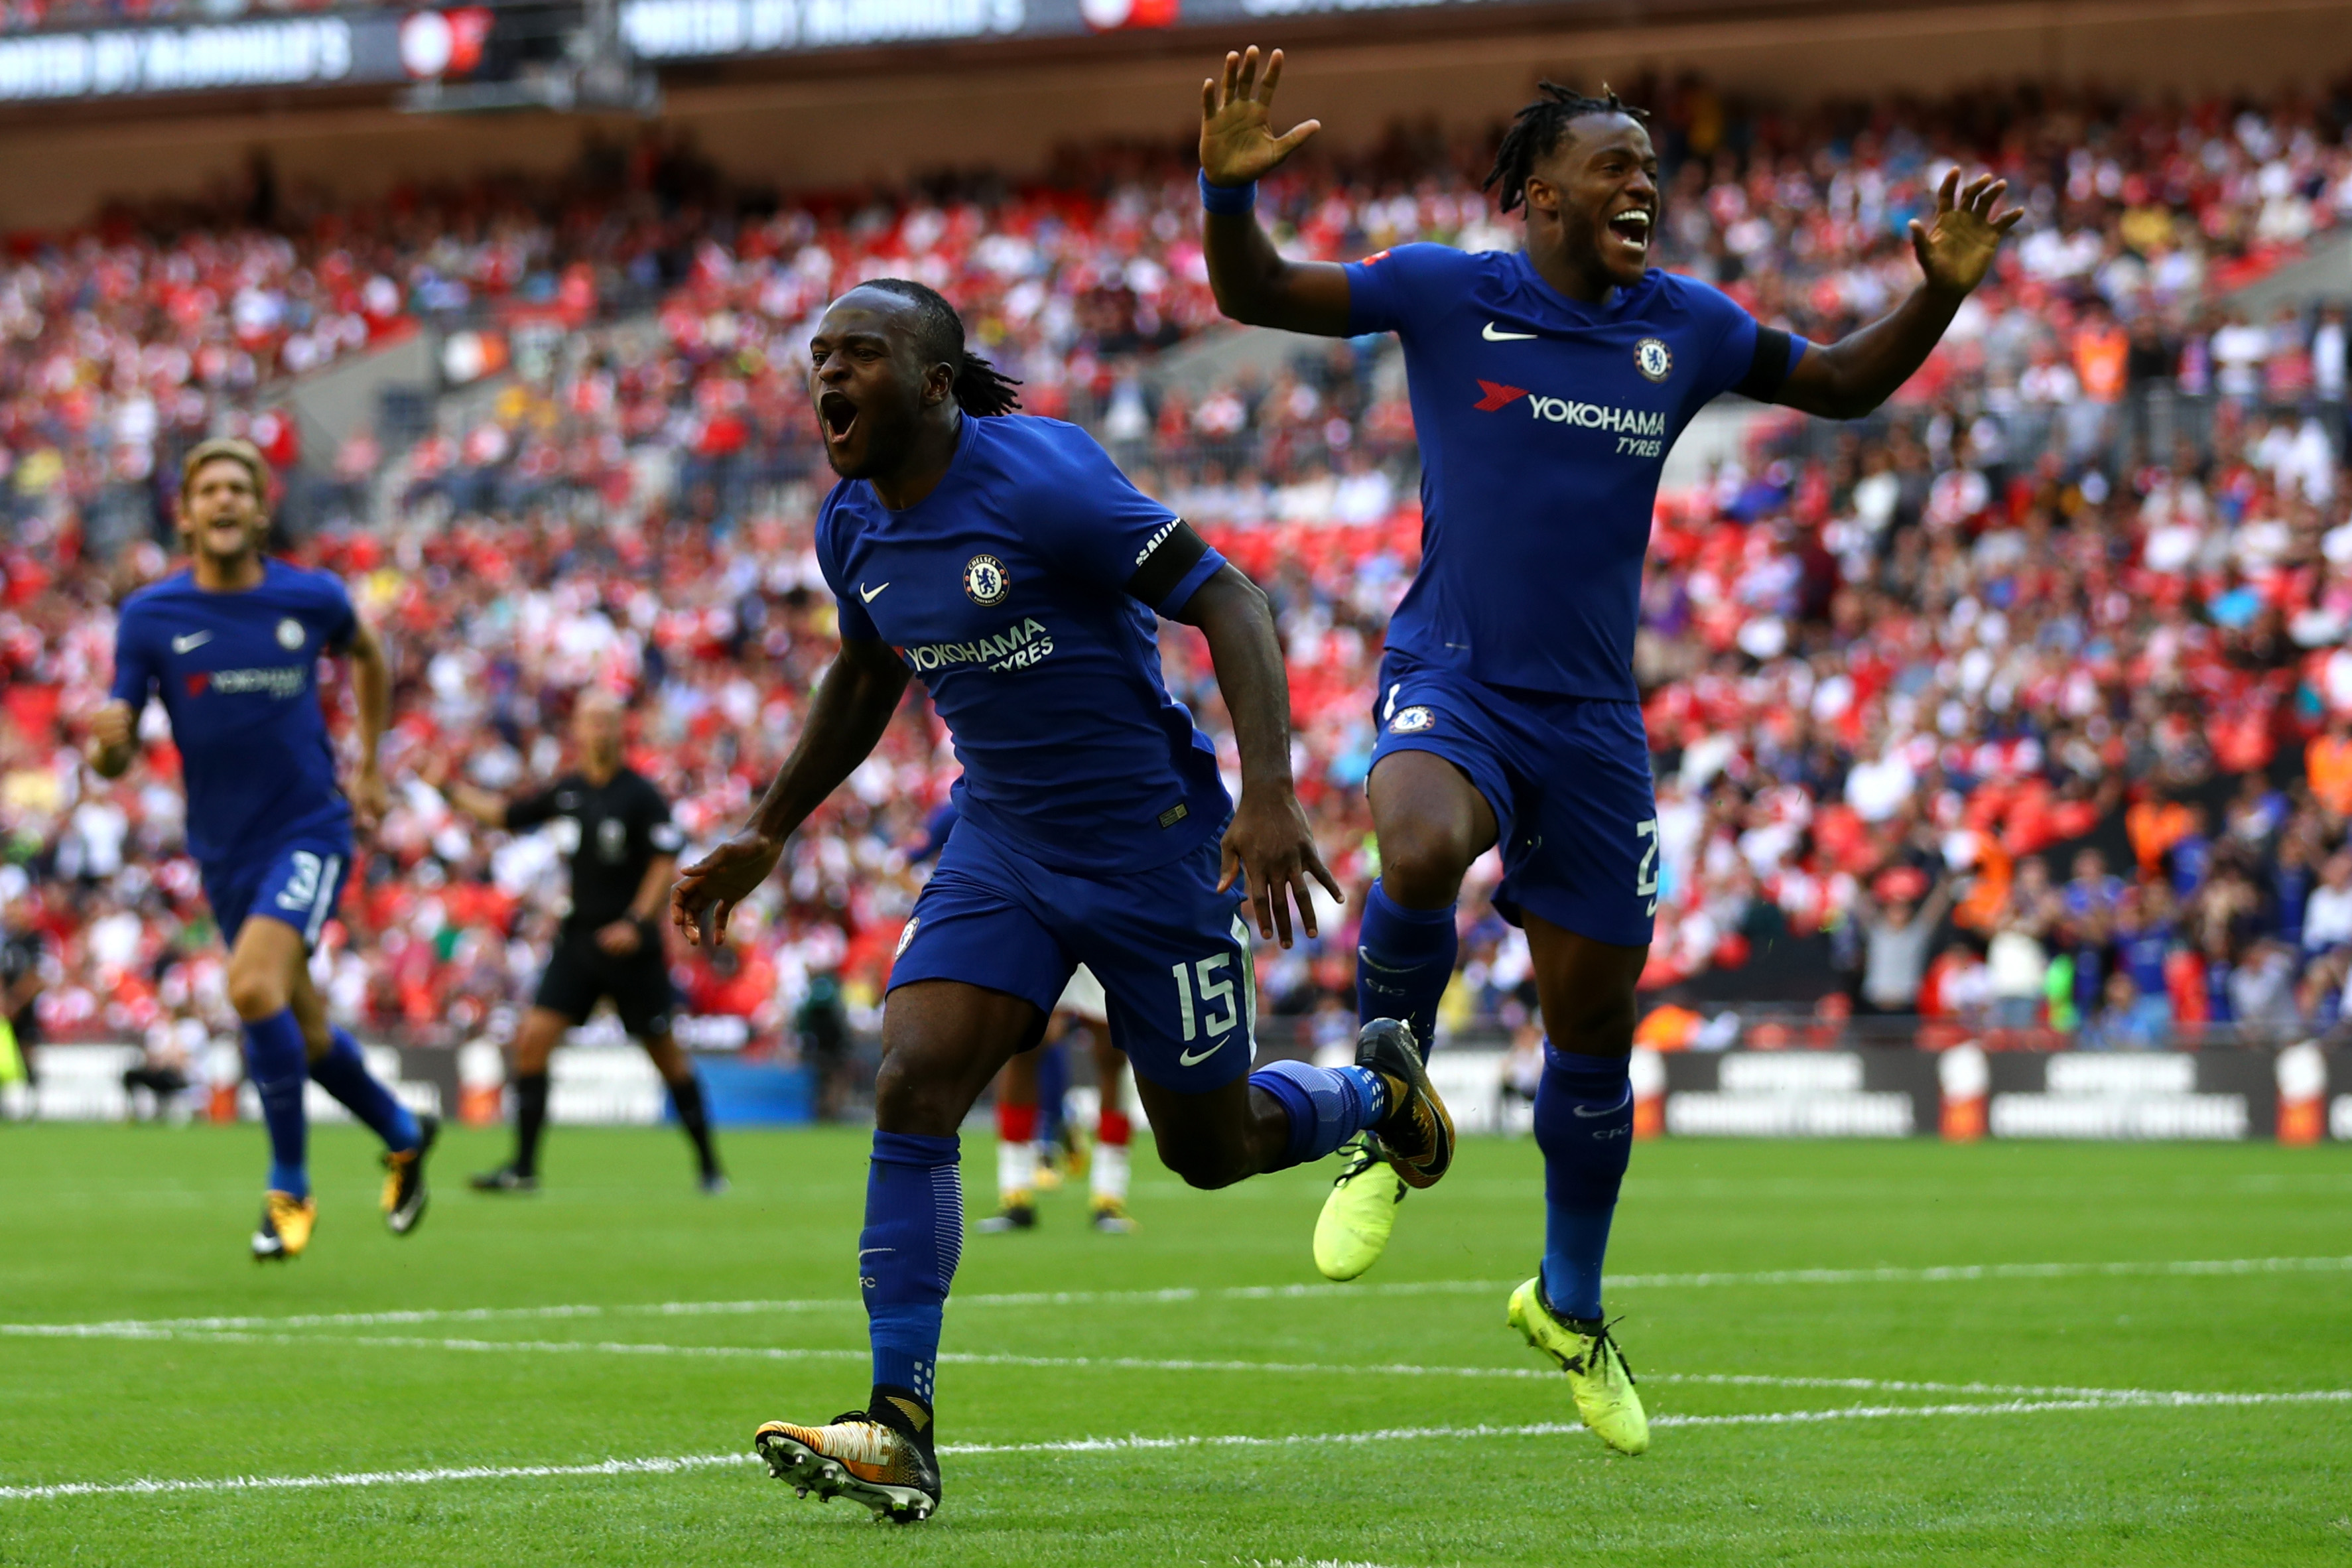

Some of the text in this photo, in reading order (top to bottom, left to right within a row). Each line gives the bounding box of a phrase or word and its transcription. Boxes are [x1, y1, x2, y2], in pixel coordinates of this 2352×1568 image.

[1528, 394, 1666, 436] YOKOHAMA
[1616, 436, 1662, 458] TYRES
[968, 556, 996, 570] CHELSEA
[905, 618, 1047, 671] YOKOHAMA
[988, 636, 1054, 673] TYRES
[276, 850, 322, 911] 3
[1172, 952, 1238, 1041] 15
[859, 1276, 876, 1289] FC
